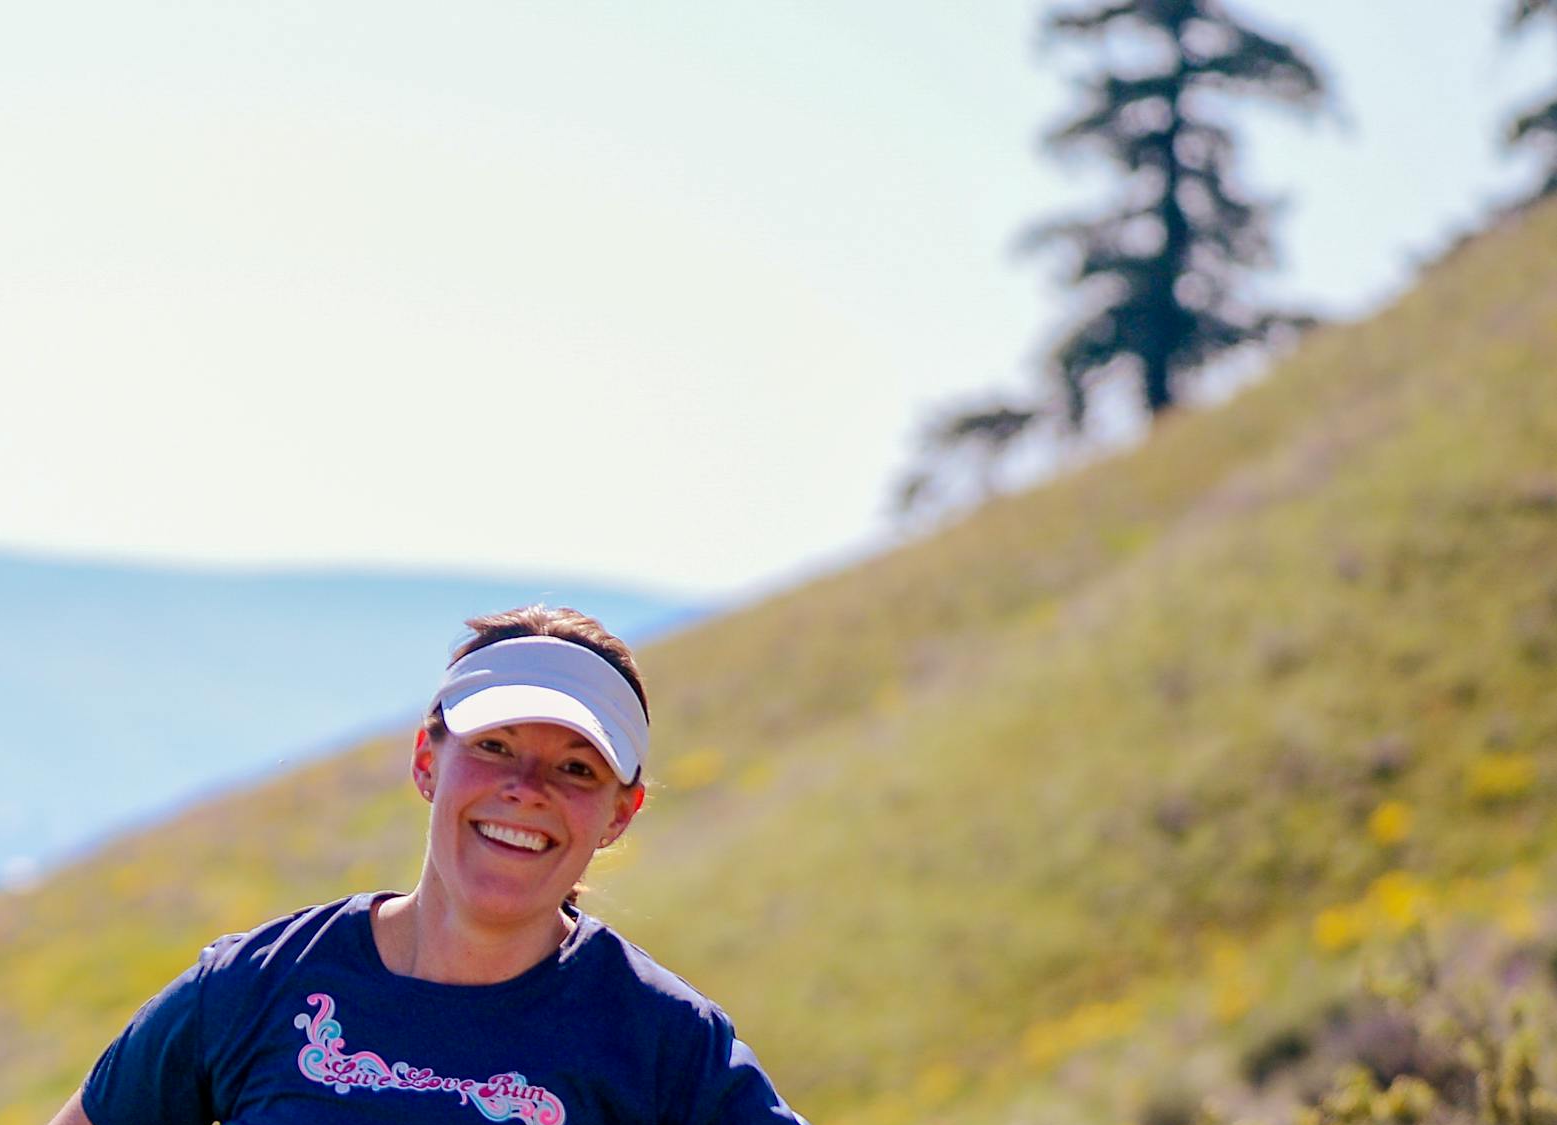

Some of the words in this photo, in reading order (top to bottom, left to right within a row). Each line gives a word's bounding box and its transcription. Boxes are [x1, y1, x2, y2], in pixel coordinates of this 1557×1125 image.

[323, 1060, 391, 1086] Live
[398, 1067, 476, 1092] Love
[478, 1074, 545, 1101] Run
